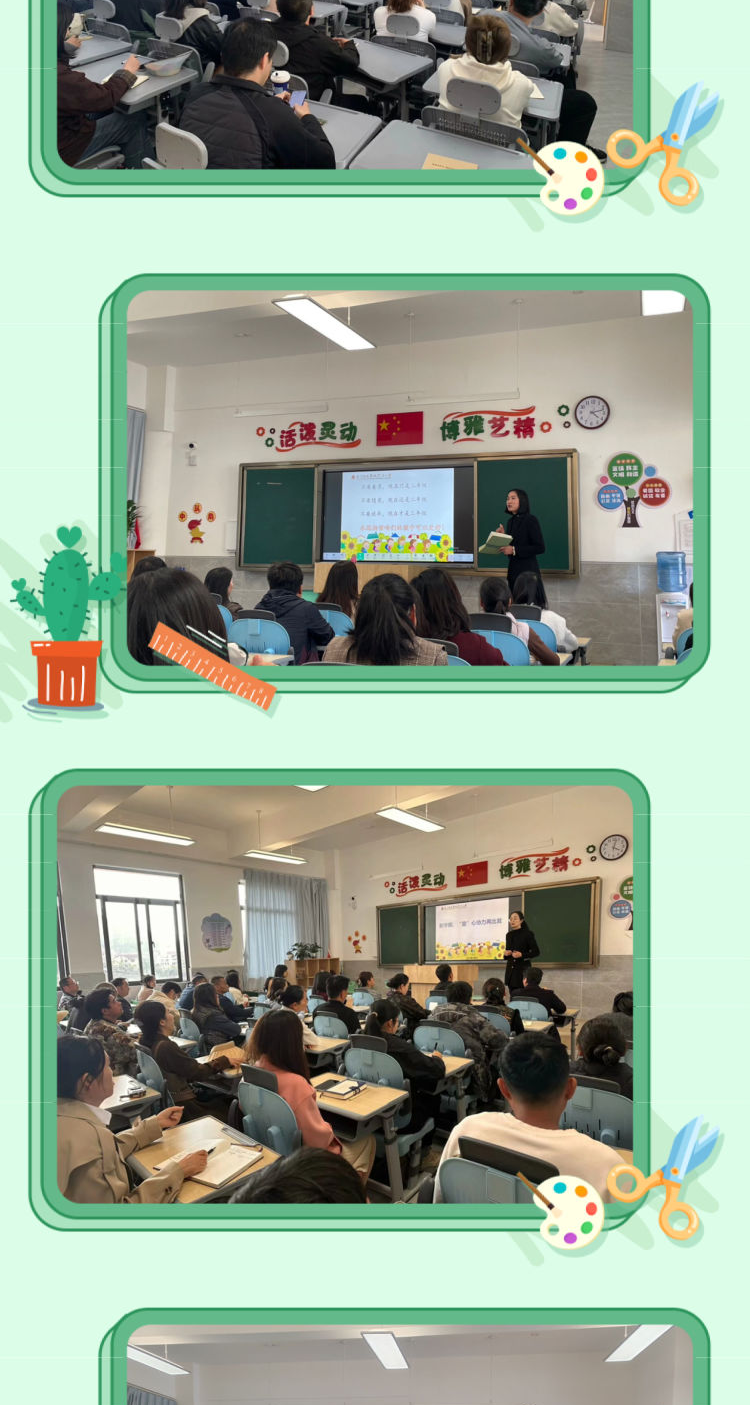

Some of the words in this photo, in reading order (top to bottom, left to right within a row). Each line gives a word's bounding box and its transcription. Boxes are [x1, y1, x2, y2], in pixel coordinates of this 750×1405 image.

[279, 421, 358, 448] 活泼灵动
[440, 415, 536, 441] 博雅艺精
[499, 855, 569, 879] 博雅艺精
[397, 872, 445, 894] 活泼灵动
